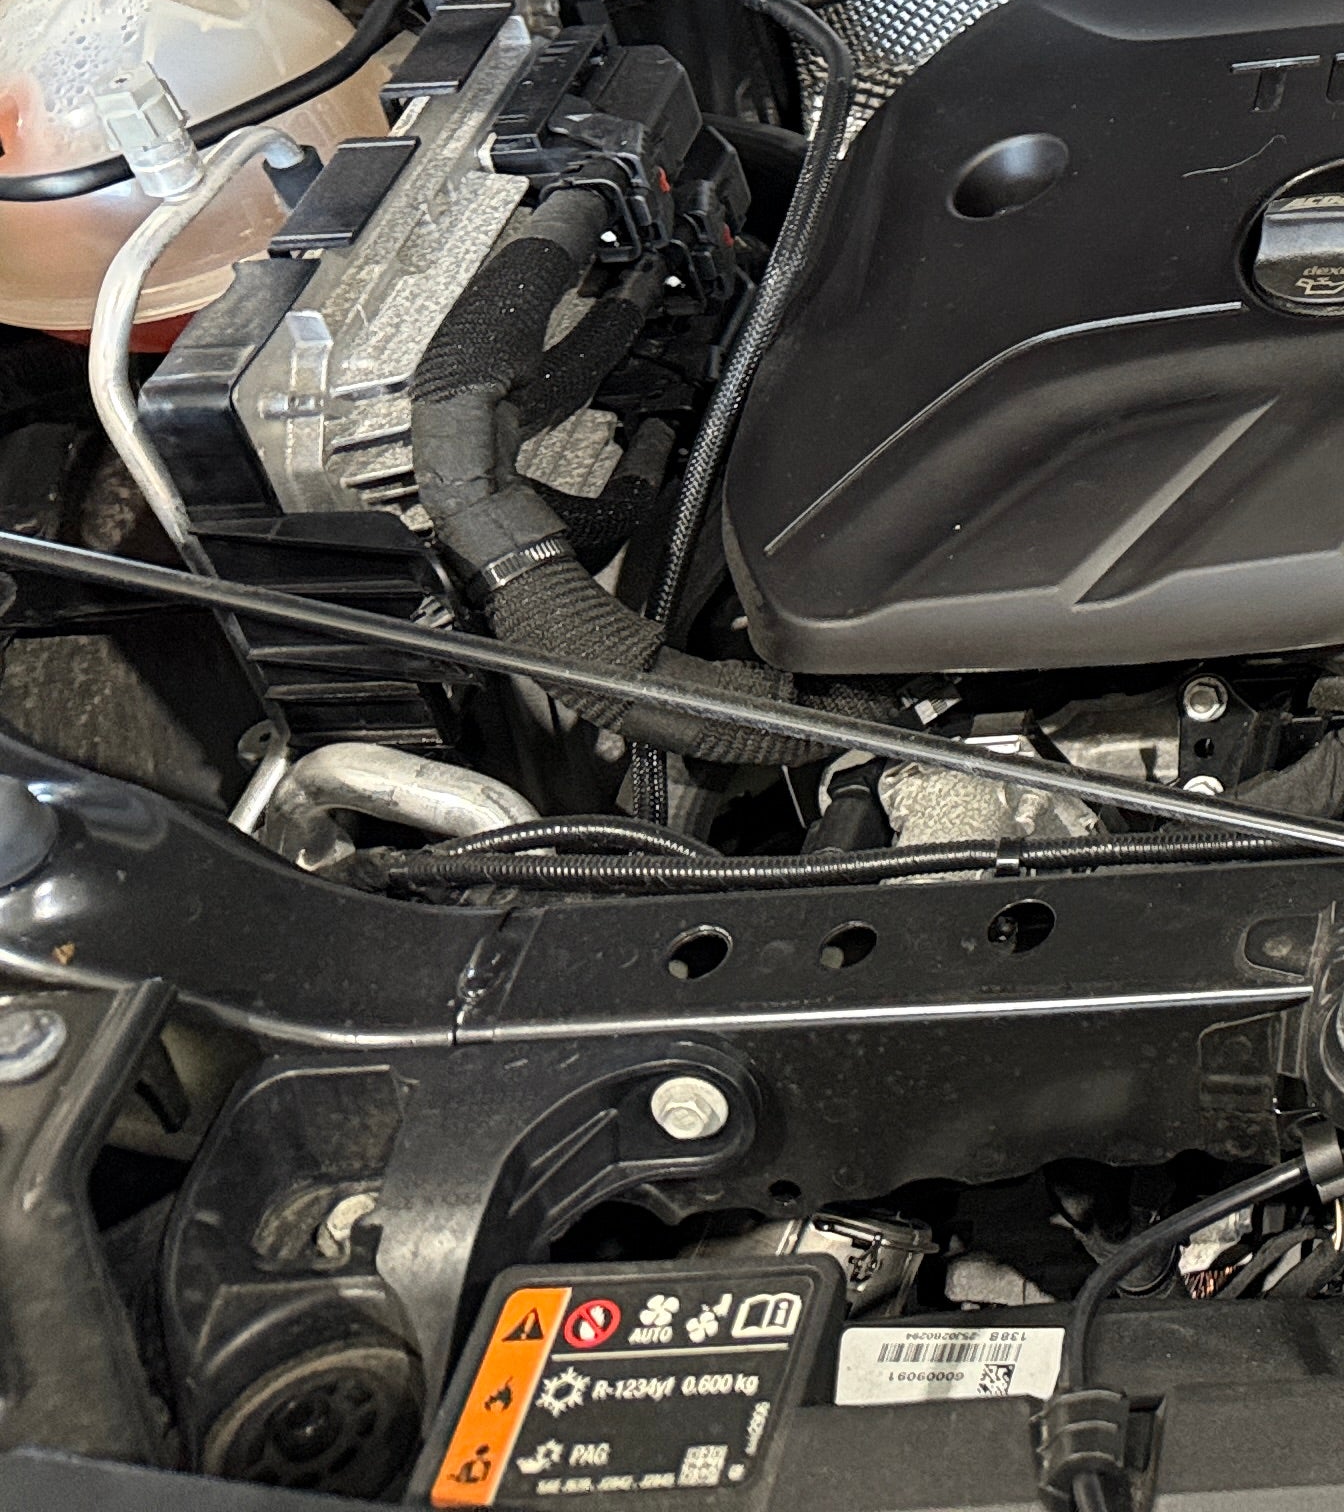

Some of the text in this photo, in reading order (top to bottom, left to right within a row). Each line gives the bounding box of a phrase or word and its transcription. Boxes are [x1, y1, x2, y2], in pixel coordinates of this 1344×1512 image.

[628, 1326, 673, 1345] AUTO
[681, 1374, 734, 1396] 0.600
[735, 1373, 760, 1397] kg
[569, 1443, 611, 1466] PAG
